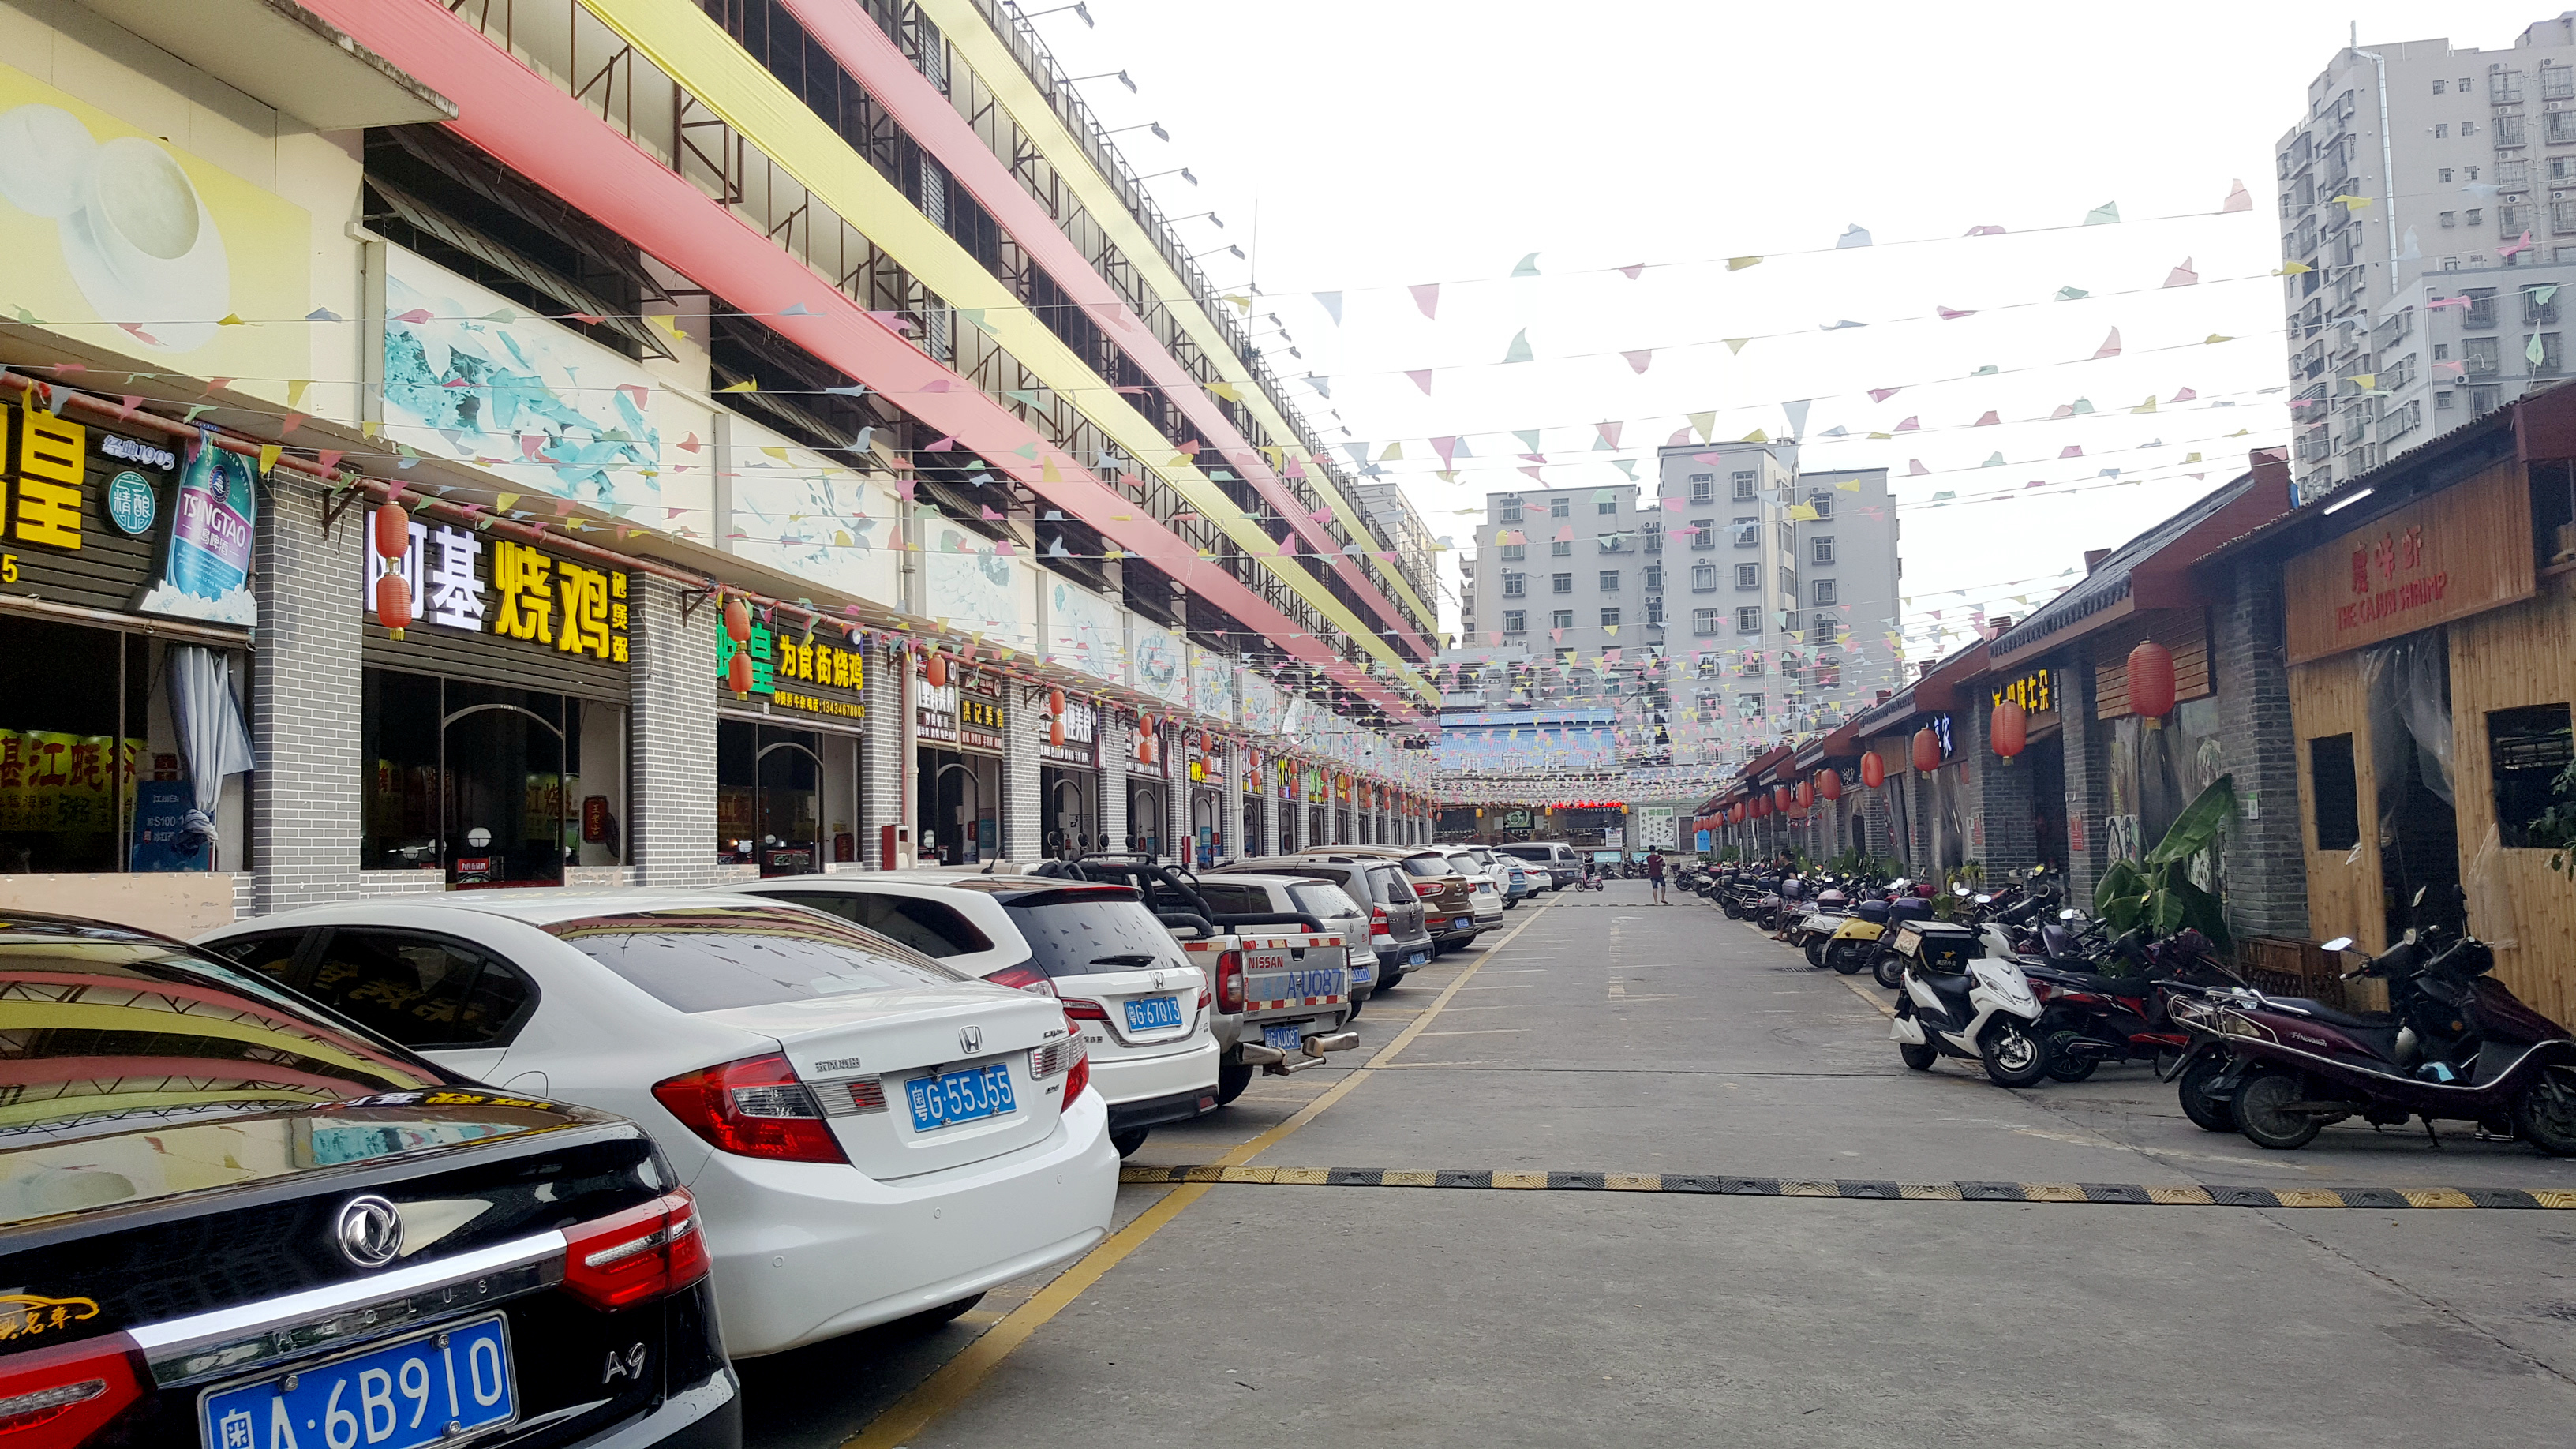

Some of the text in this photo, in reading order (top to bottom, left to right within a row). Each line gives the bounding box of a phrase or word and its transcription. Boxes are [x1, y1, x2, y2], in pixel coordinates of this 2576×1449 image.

[0, 402, 85, 550] 皇
[102, 435, 175, 470] 经典1903
[183, 492, 246, 548] TSINGTAO
[2336, 571, 2447, 631] THE CAJUN SHRIMP
[779, 635, 863, 691] 为食街烧鸡
[963, 700, 1004, 728] 洪记美食
[1248, 955, 1284, 970] NISSAN
[603, 1342, 648, 1385] A9
